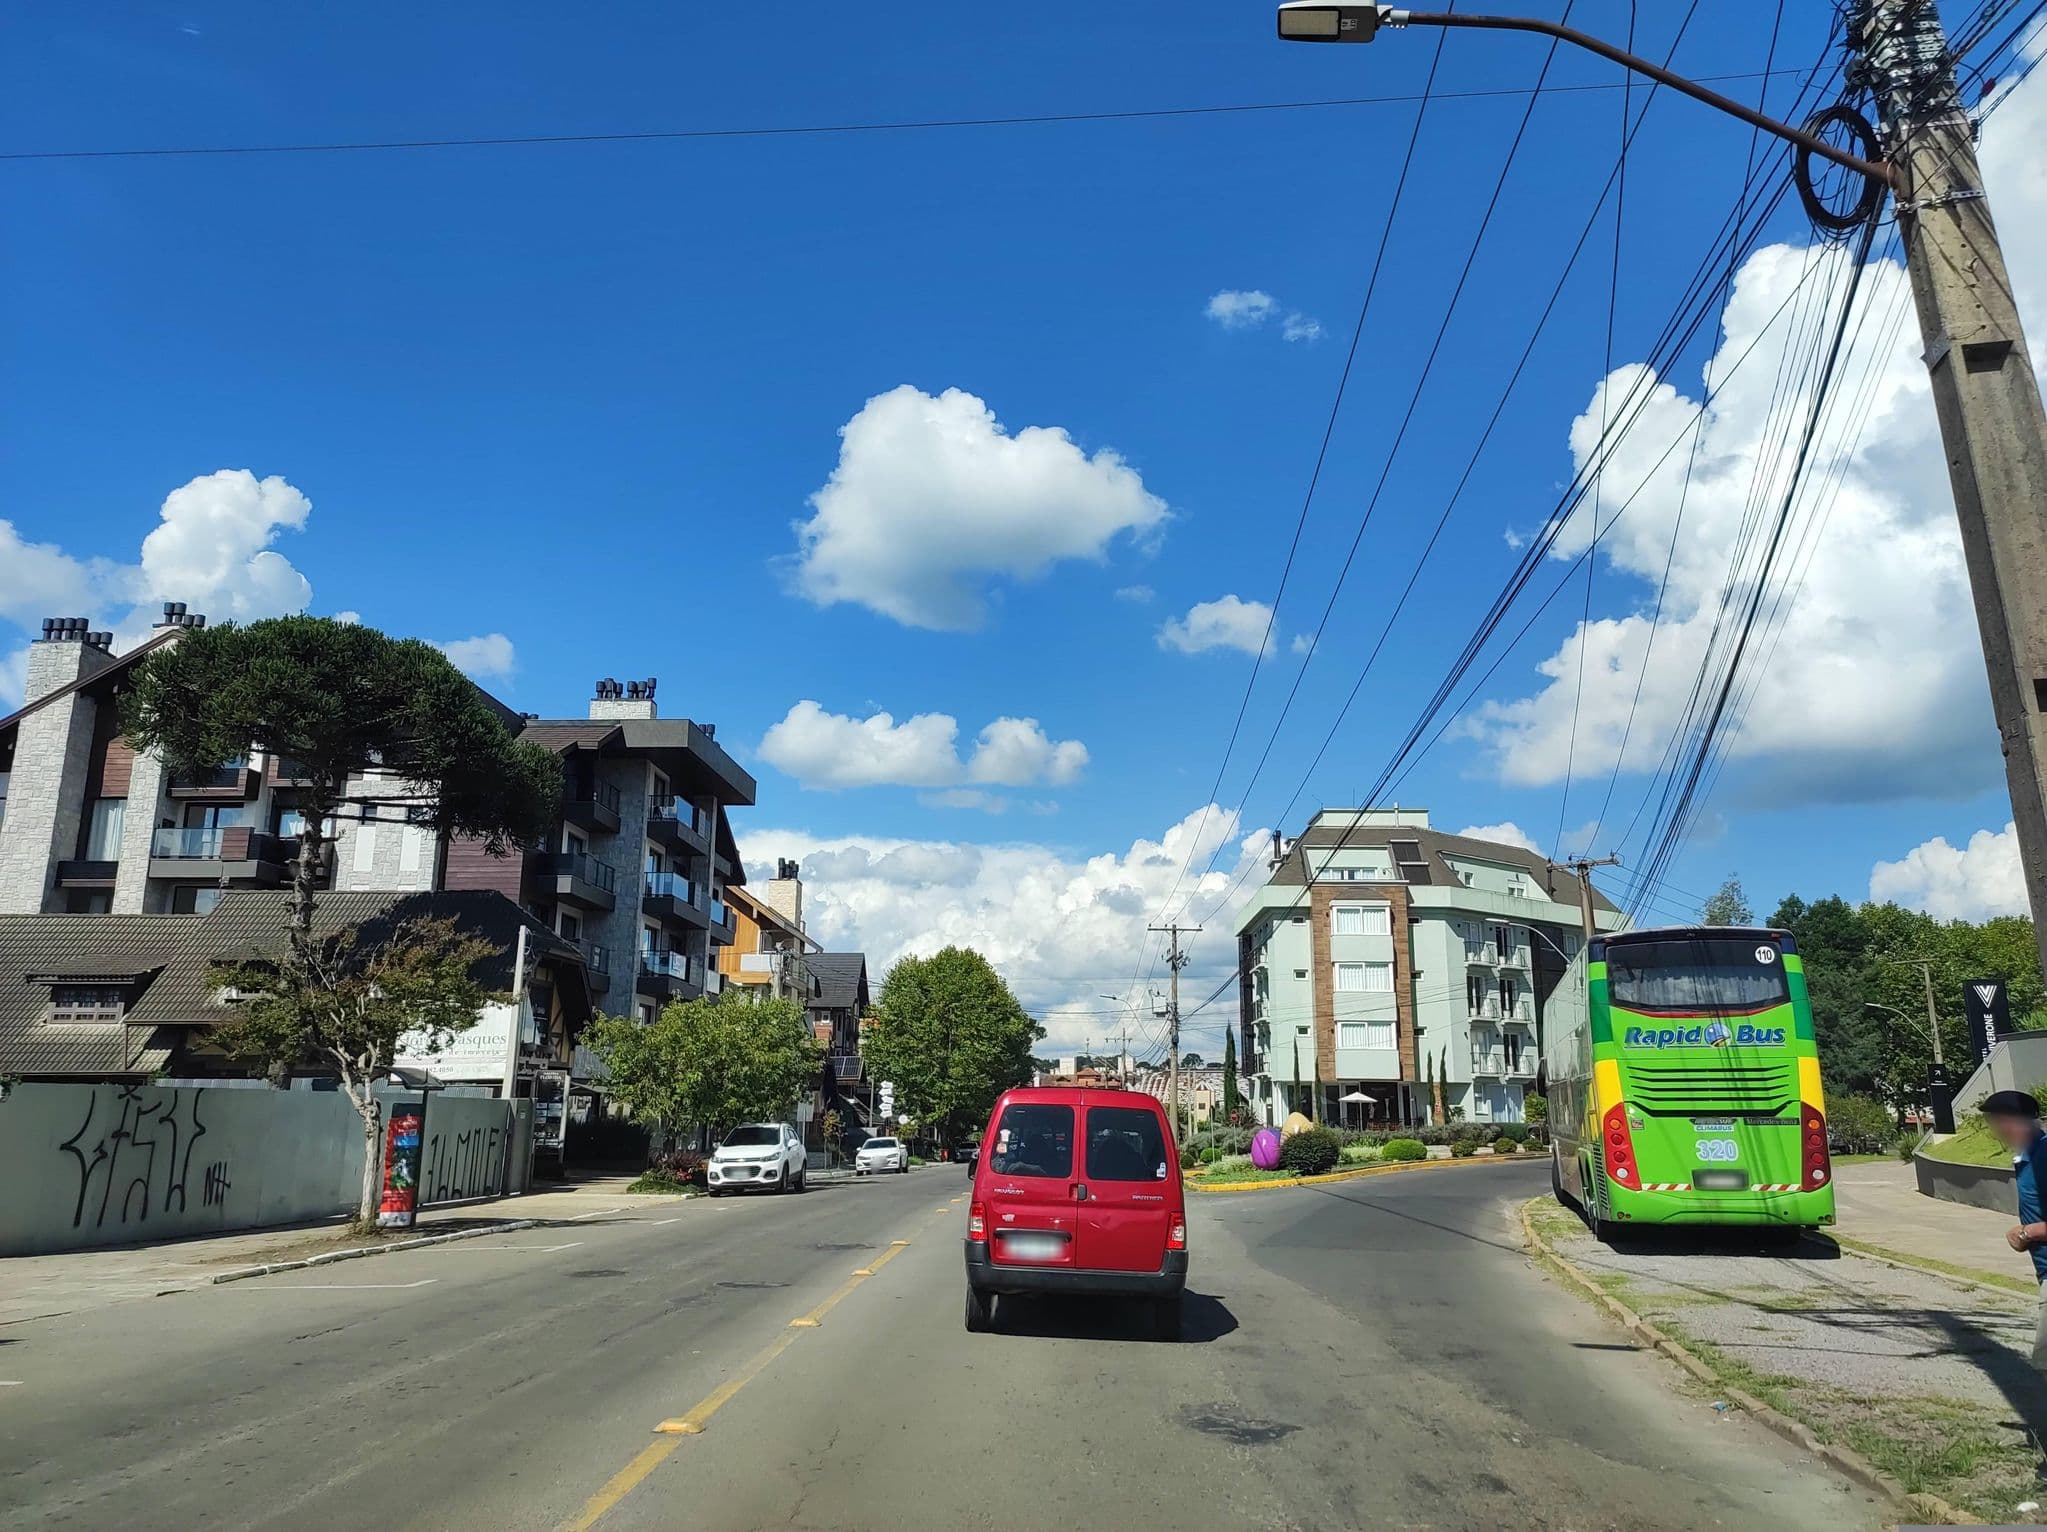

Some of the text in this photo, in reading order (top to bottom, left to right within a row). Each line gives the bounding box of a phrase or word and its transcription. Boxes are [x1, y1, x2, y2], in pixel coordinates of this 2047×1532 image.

[1756, 949, 1772, 961] 110
[1624, 1024, 1786, 1049] Rapid Bus
[1696, 1139, 1738, 1161] 320
